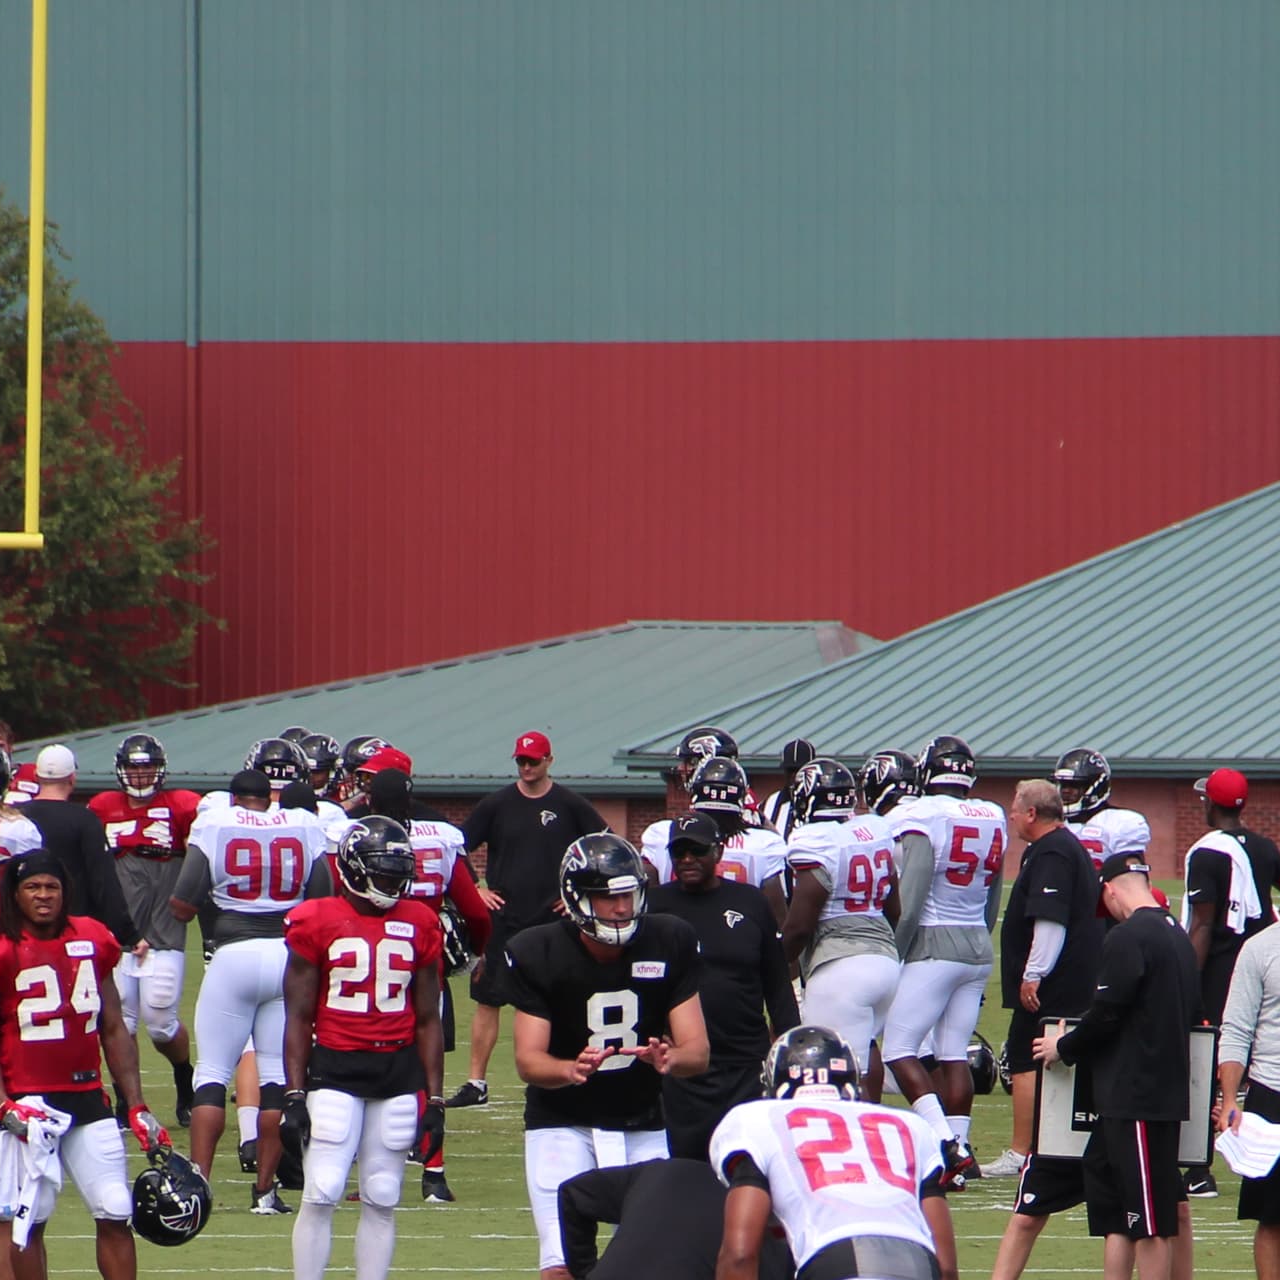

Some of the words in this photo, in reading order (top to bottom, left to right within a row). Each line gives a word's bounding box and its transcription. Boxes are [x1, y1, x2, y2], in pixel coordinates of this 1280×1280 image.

[273, 768, 286, 776] 71
[952, 761, 966, 772] 54
[225, 837, 304, 901] 90
[844, 848, 893, 912] 92
[945, 825, 1003, 887] 54
[15, 959, 101, 1041] 24
[326, 937, 414, 1013] 26
[587, 989, 639, 1071] 8
[803, 1068, 828, 1084] 20
[785, 1107, 917, 1197] 20
